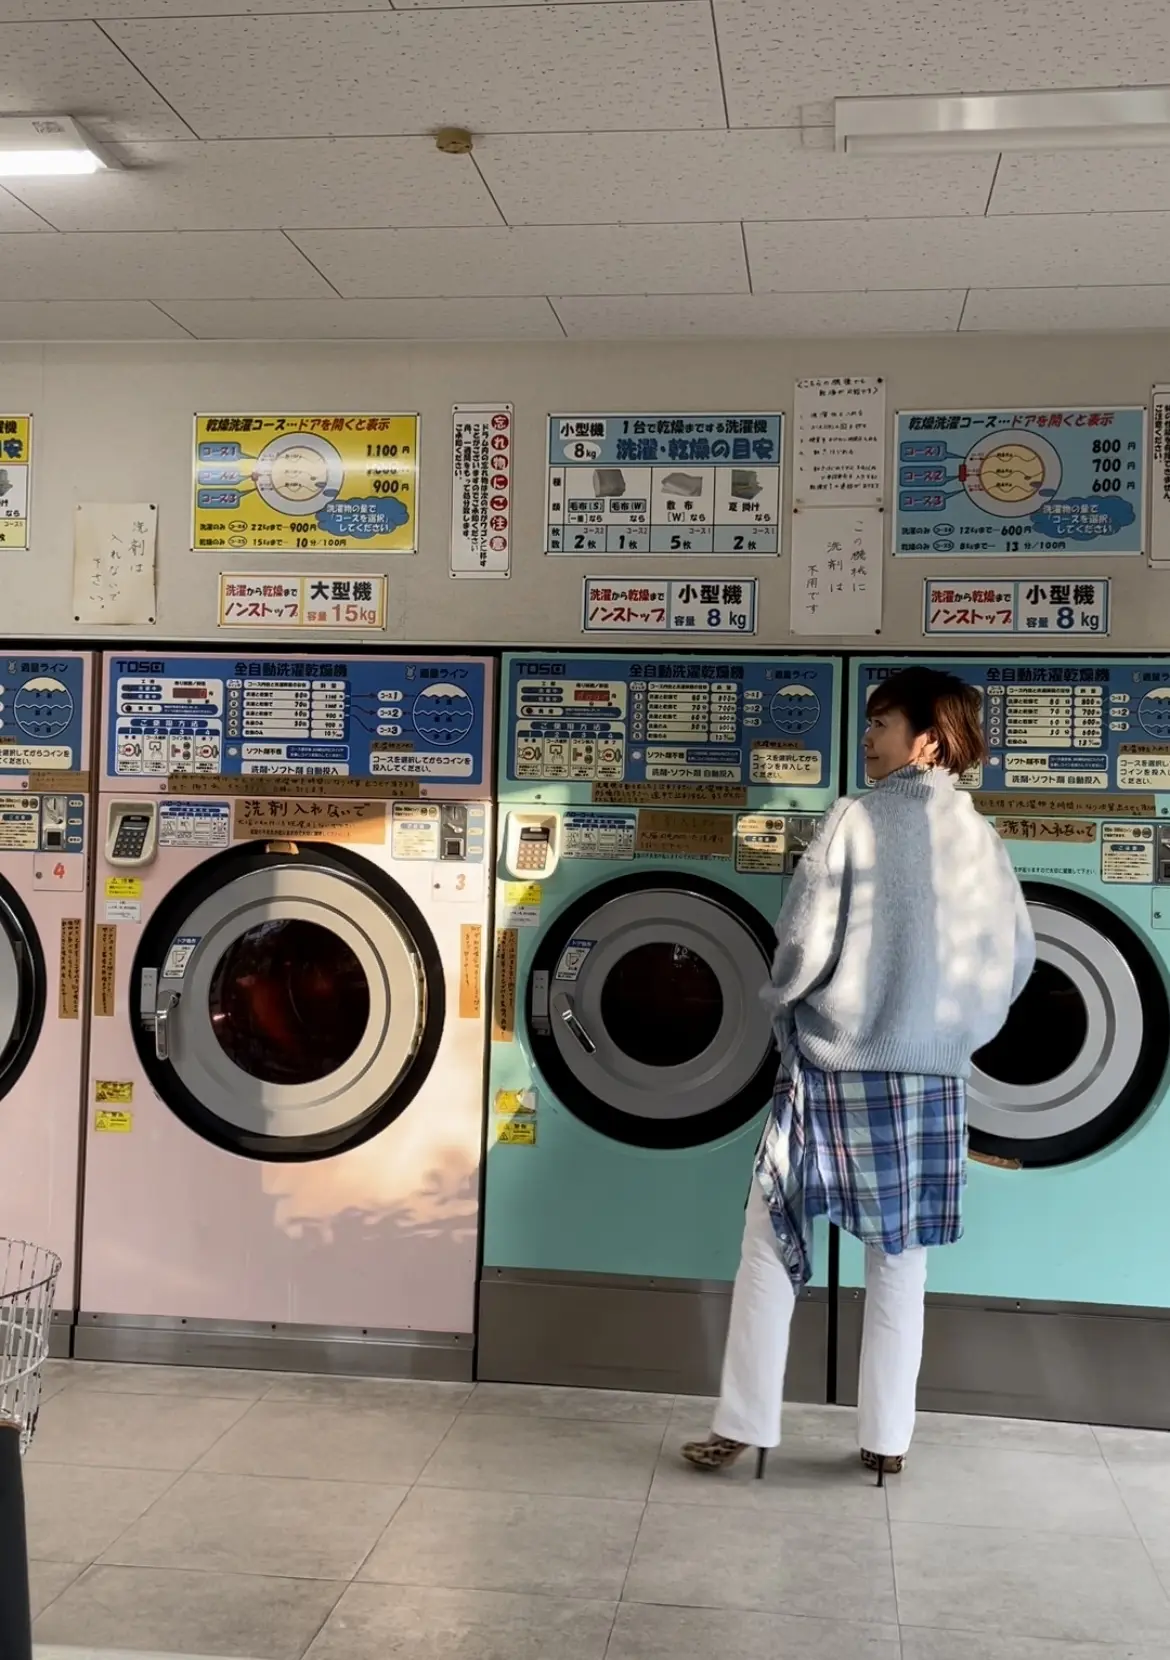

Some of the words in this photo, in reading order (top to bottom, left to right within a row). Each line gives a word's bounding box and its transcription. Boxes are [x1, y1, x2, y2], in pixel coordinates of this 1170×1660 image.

[561, 422, 605, 437] 小型機
[0, 438, 24, 459] 安
[202, 446, 237, 457] コース1
[616, 437, 774, 460] 洗濯・乾燥の目安
[904, 445, 941, 457] コース1
[490, 415, 508, 551] 忘れ物にご注意
[904, 471, 944, 481] コース2
[201, 493, 237, 504] コース3
[904, 496, 942, 507] コース3
[326, 504, 376, 514] 洗濯物の量で
[1042, 504, 1099, 514] 洗濯物の量で
[629, 514, 646, 523] なら
[754, 513, 771, 522] なら
[199, 523, 226, 532] 洗濯のみ
[901, 526, 930, 535] 洗濯のみ
[128, 521, 149, 573] 洗剤は
[199, 538, 226, 546] 乾燥のみ
[901, 542, 930, 551] 乾燥のみ
[850, 520, 868, 592] この機械に
[109, 534, 124, 601] 入れないで
[827, 541, 845, 593] 洗剤は
[225, 584, 298, 598] 洗濯から乾燥まで
[310, 580, 372, 601] 大型機
[589, 588, 665, 602] 洗濯から乾燥まで
[678, 584, 743, 605] 小型機
[806, 564, 820, 615] 不用です
[931, 589, 1012, 604] 洗濯から乾燥まで
[1026, 584, 1096, 605] 小型機
[224, 602, 299, 618] ノンストップ
[307, 611, 328, 622] 容量
[589, 606, 665, 623] ノンストップ
[931, 608, 1012, 625] ノンストップ
[674, 615, 696, 627] 容量
[1026, 617, 1049, 628] 容量
[116, 661, 165, 674] TOSEI
[233, 662, 348, 678] 全自動洗濯乾燥機
[516, 663, 566, 676] TOSEI
[628, 664, 744, 679] 全自動洗濯乾燥機
[986, 667, 1111, 682] 全自動洗濯乾燥機
[0, 757, 33, 766] ください。
[373, 756, 472, 765] コースを選択してからコインを
[373, 764, 432, 773] 投入してください。
[244, 800, 371, 818] 洗剤入れないで
[1002, 819, 1096, 838] 洗剤入れないで
[52, 863, 66, 879] 4
[455, 873, 466, 891] 3
